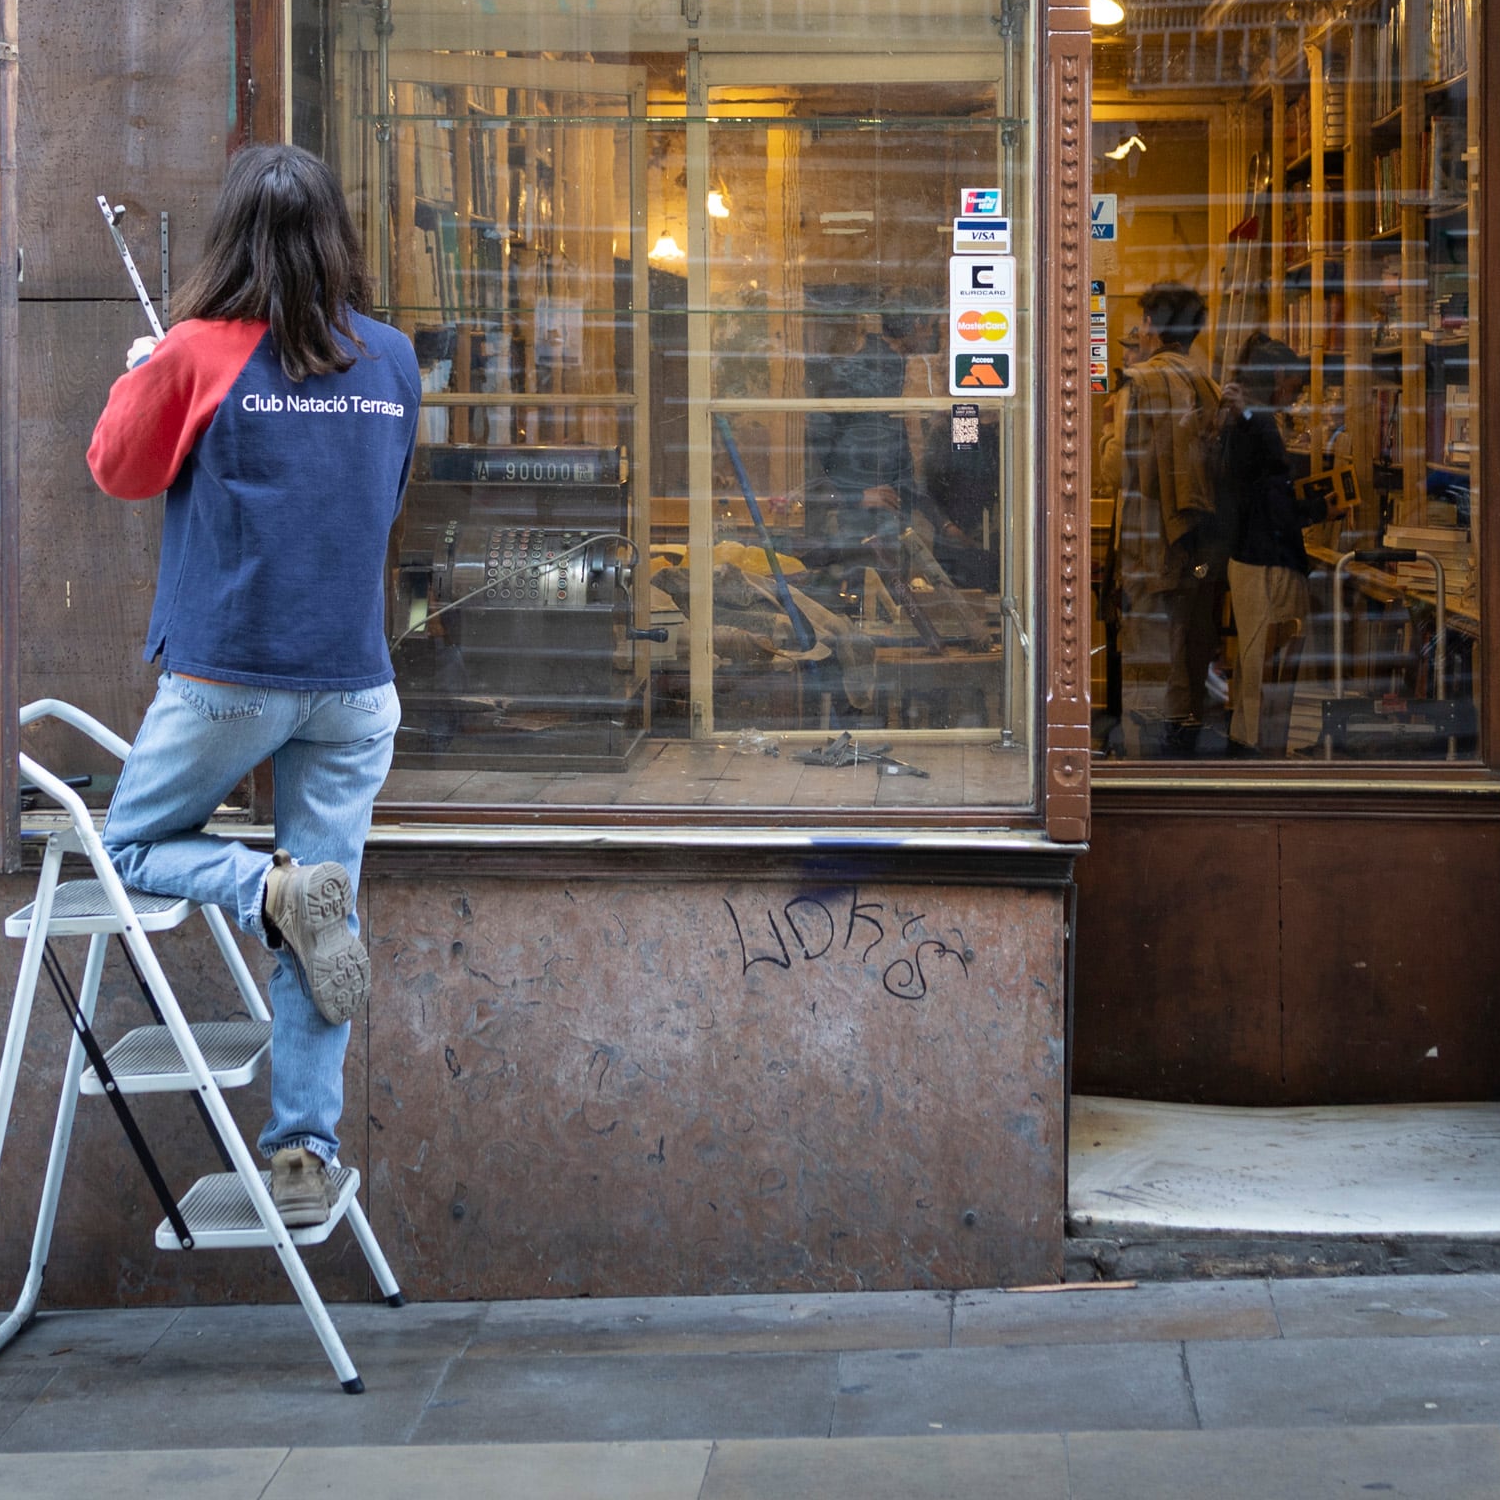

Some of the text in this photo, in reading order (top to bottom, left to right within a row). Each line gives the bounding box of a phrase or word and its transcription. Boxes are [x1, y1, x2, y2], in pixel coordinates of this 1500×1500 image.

[971, 231, 996, 241] VISA
[1091, 226, 1107, 237] AY
[957, 322, 1007, 331] MasterCard
[971, 356, 994, 364] Access
[242, 394, 404, 418] Club Natació Terrassa
[477, 460, 489, 481] A
